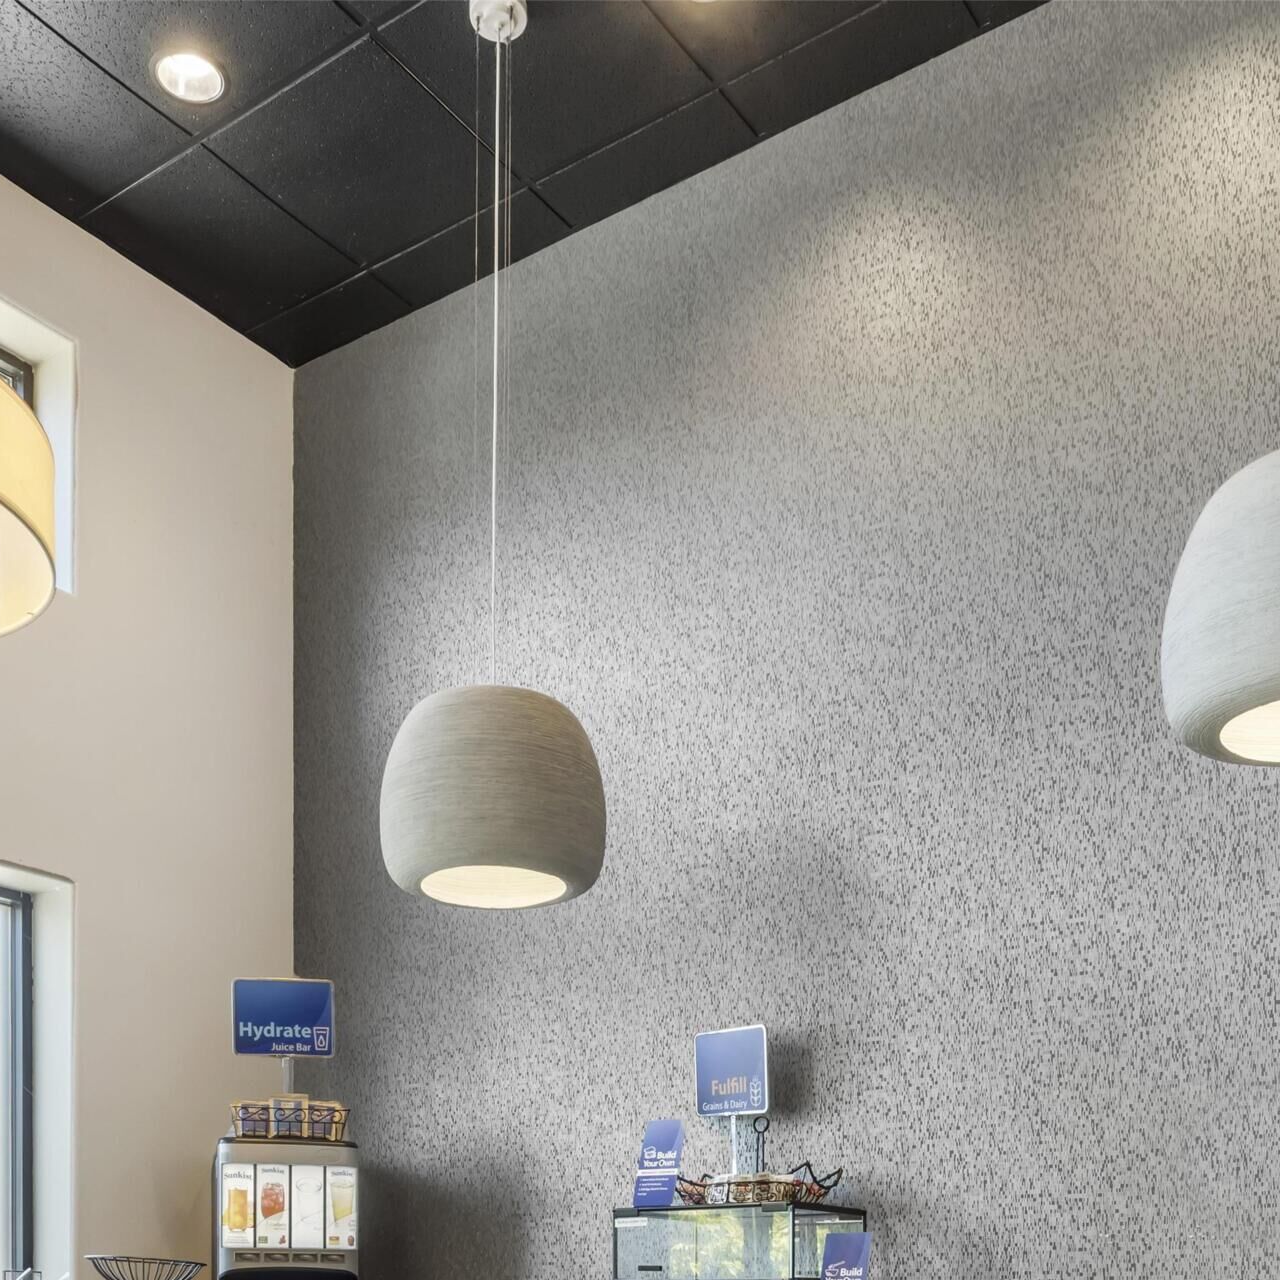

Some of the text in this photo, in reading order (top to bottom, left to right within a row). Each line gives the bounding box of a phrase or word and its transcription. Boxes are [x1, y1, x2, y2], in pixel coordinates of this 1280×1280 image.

[239, 1022, 312, 1041] Hydrate
[272, 1042, 312, 1052] Juice Bar
[712, 1076, 747, 1096] Fulfill
[702, 1099, 748, 1111] Grains & Dairy
[657, 1150, 677, 1159] Build
[840, 1267, 862, 1276] Build
